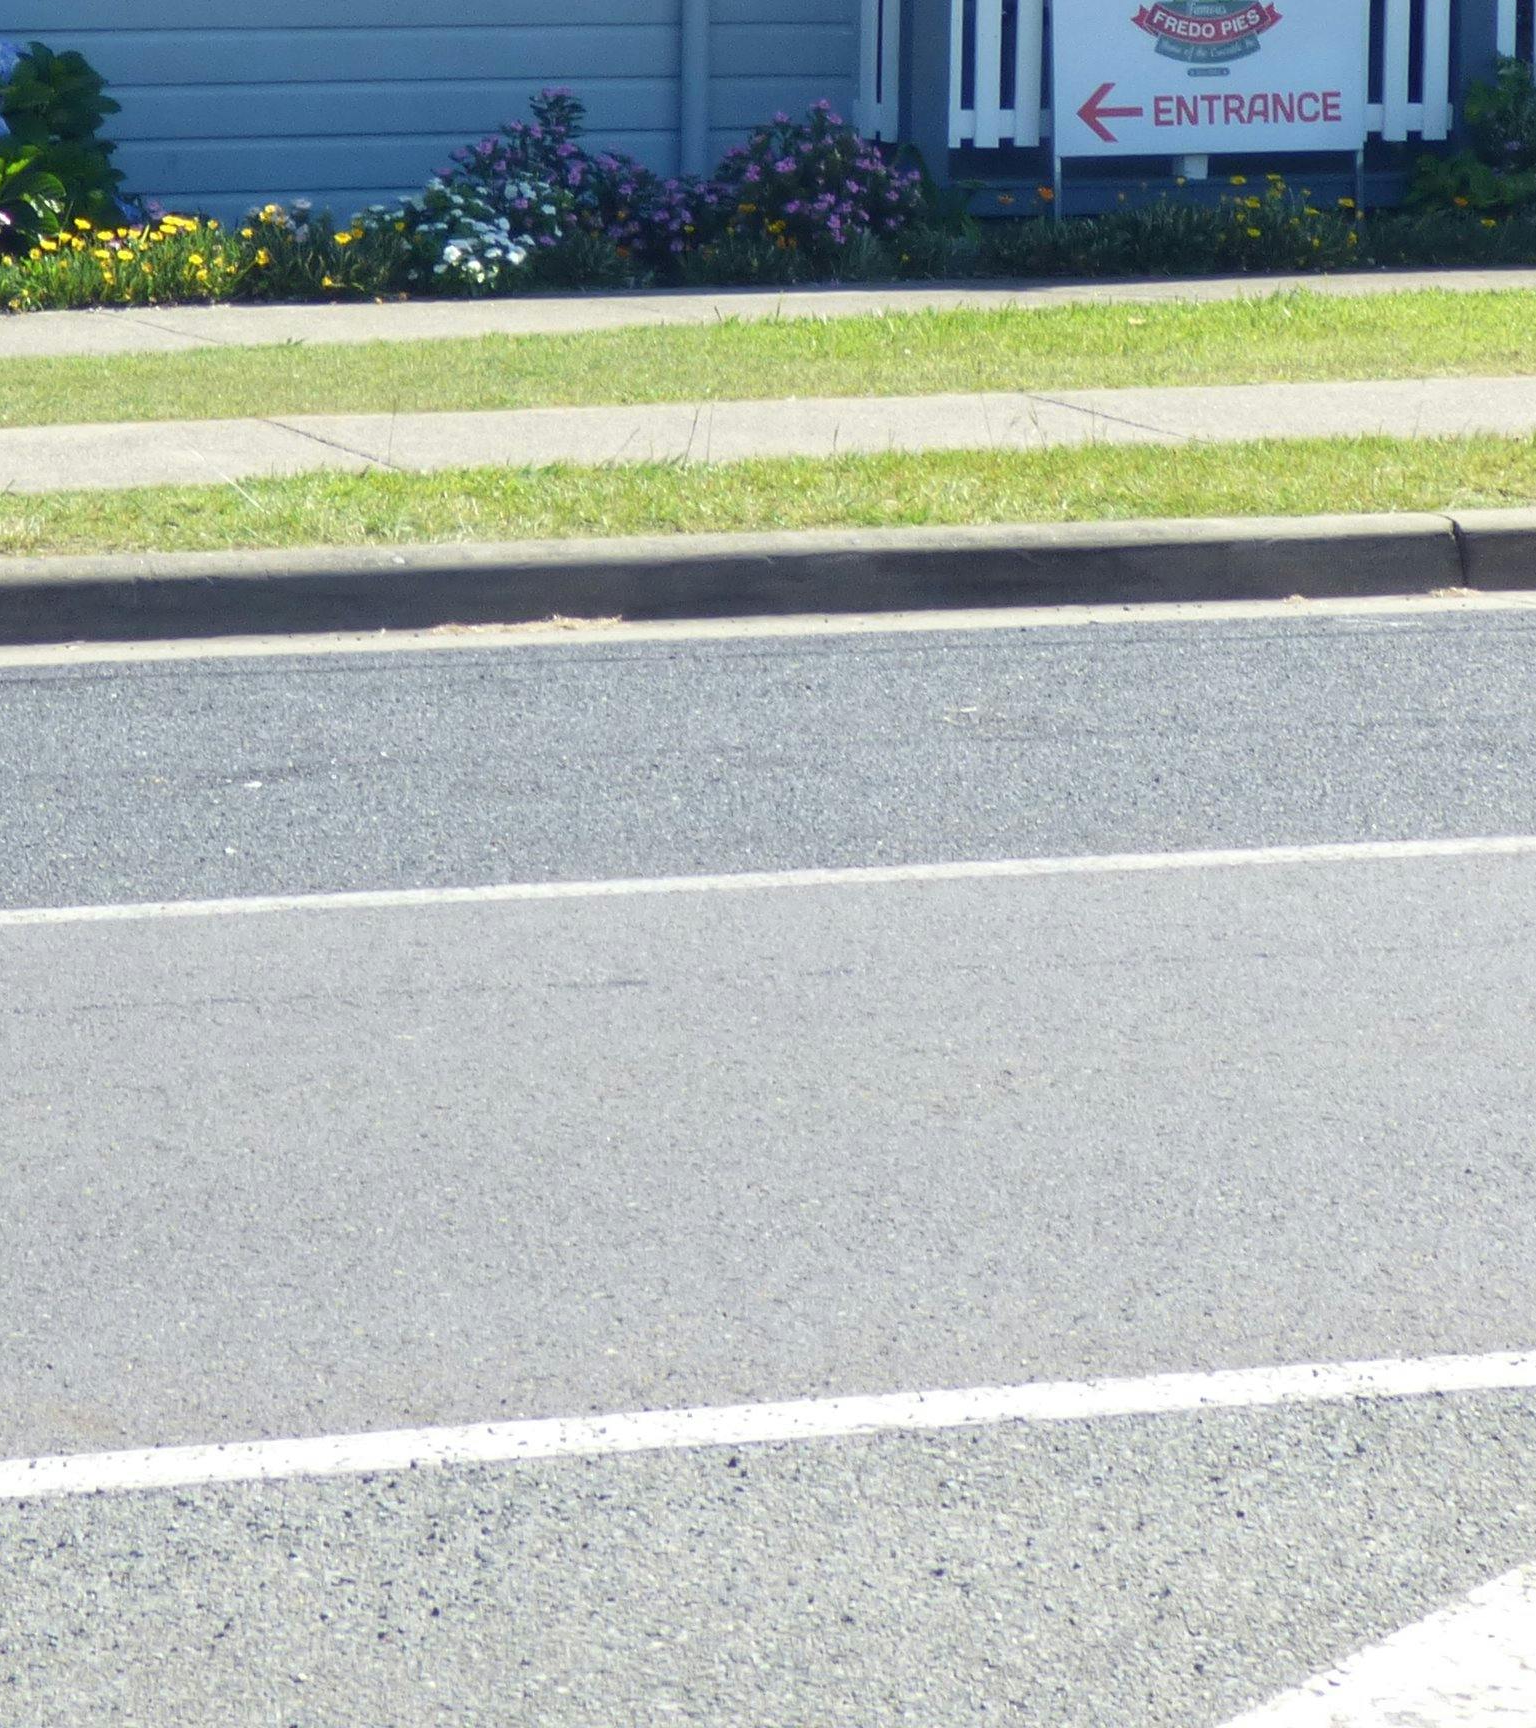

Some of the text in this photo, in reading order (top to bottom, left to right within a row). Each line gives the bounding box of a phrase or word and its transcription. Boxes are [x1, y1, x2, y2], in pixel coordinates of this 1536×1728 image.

[1153, 9, 1261, 38] FREDO PIES
[1153, 91, 1342, 127] ENTRANCE
